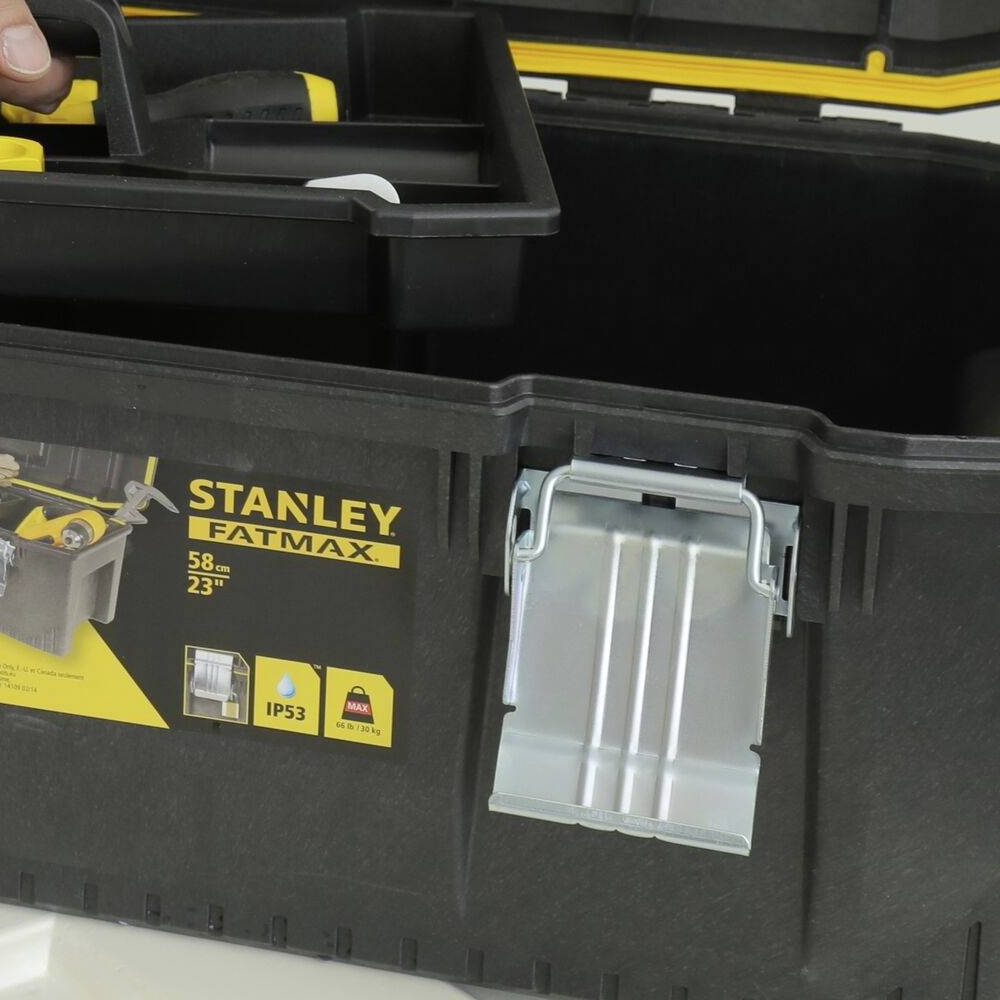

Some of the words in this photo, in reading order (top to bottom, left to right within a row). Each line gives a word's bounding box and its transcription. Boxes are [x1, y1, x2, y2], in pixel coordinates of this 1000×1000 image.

[188, 478, 402, 536] STANLEY
[209, 521, 374, 562] FATMAX
[187, 550, 214, 570] 58
[216, 563, 230, 573] cm
[187, 575, 224, 596] 23"
[266, 701, 306, 722] IP53
[346, 700, 369, 713] MAX
[347, 722, 354, 730] lb
[372, 726, 381, 736] kg
